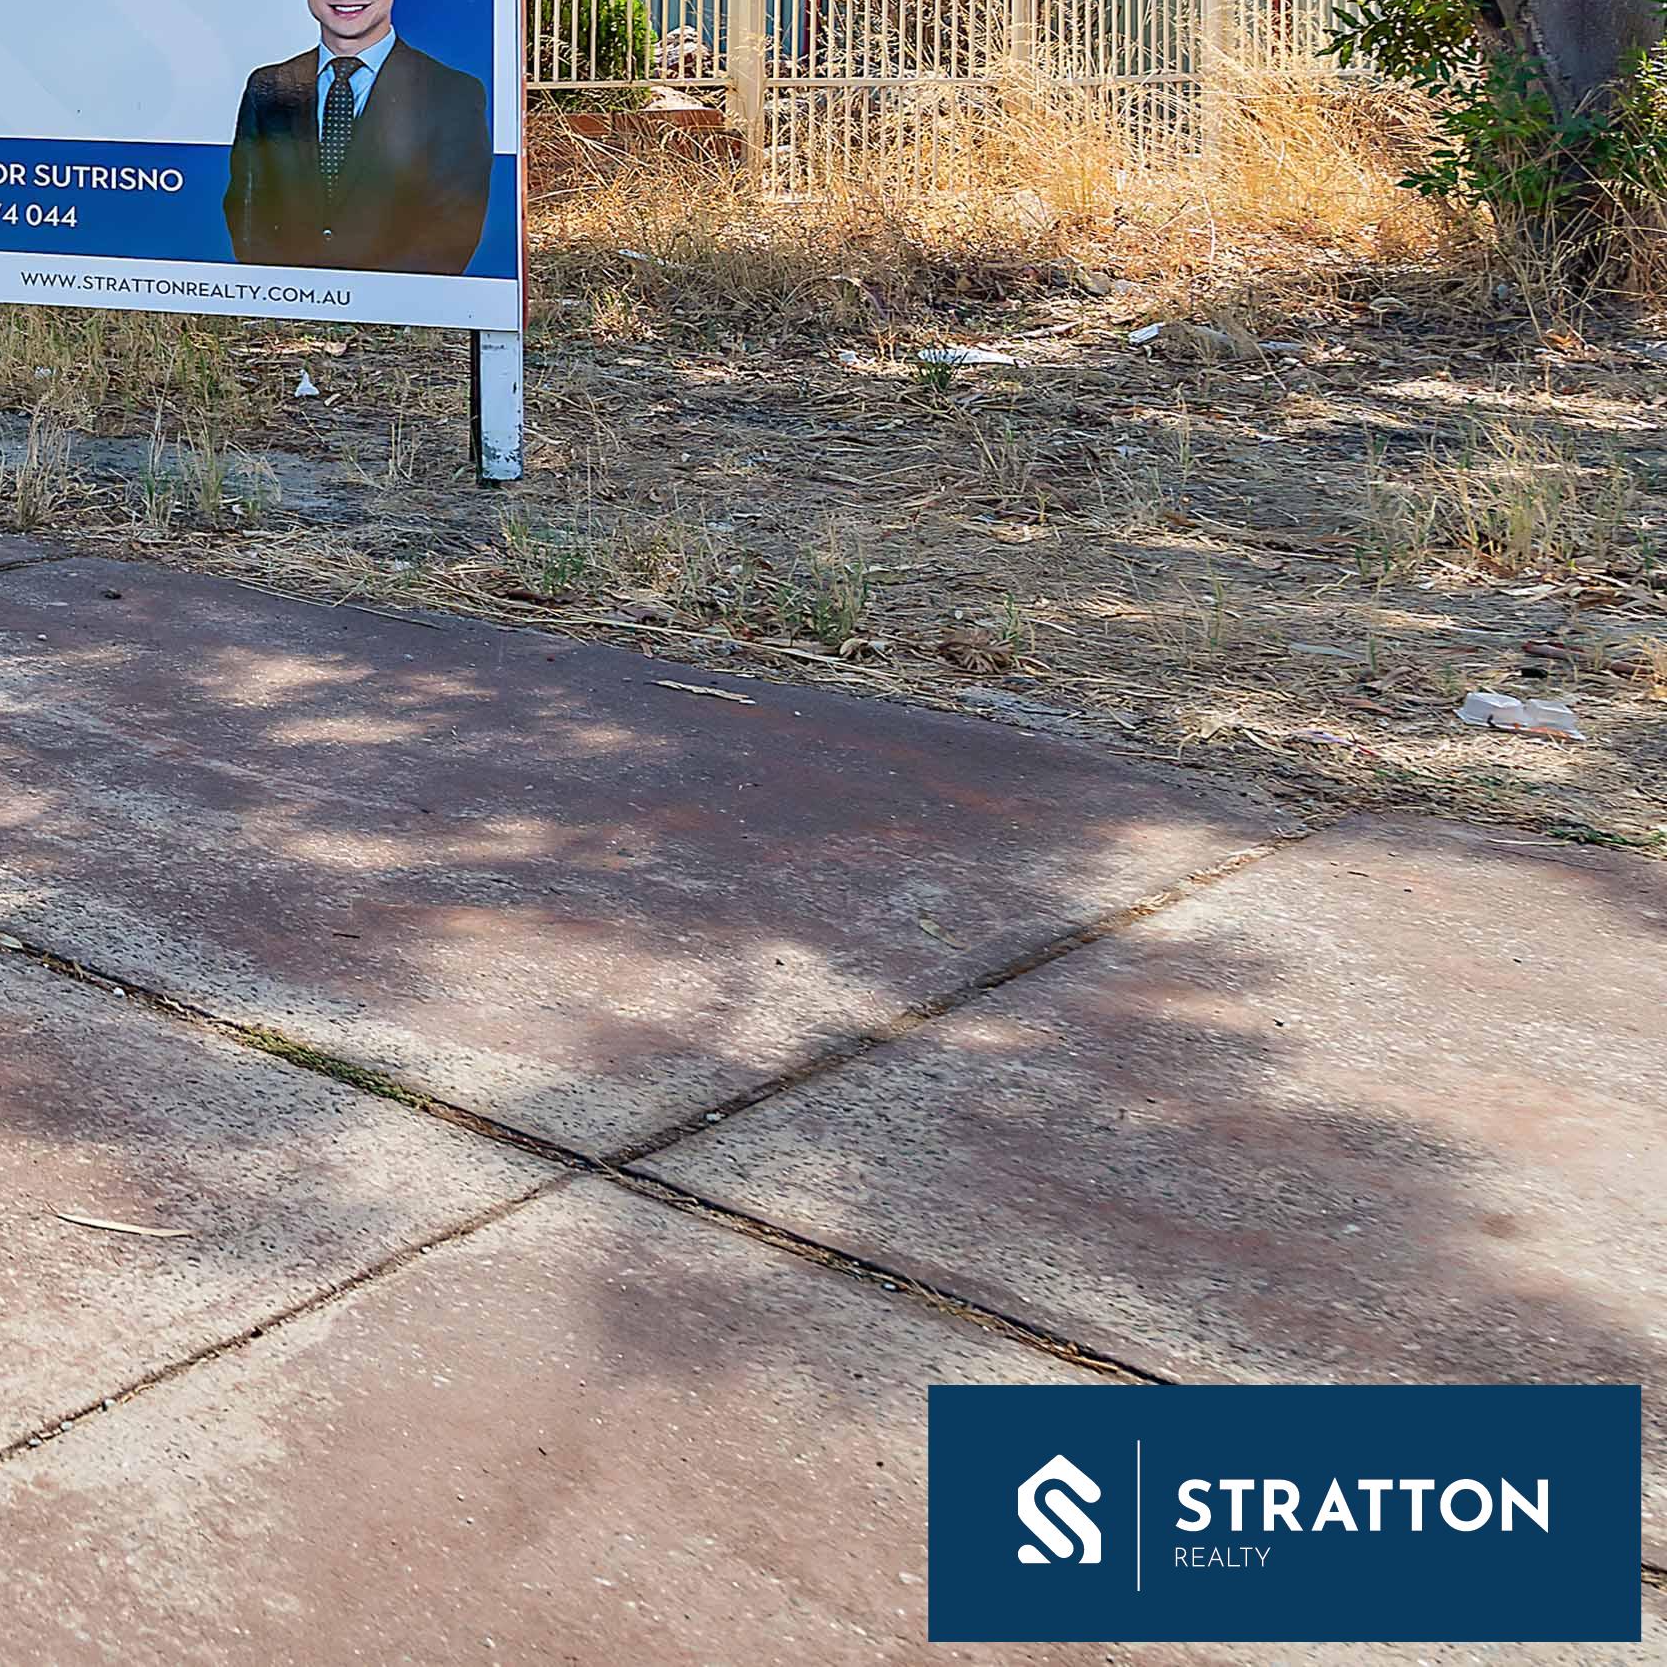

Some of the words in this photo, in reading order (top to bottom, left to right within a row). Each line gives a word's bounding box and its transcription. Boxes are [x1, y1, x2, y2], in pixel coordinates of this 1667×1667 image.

[33, 164, 184, 192] SUTRISNO
[25, 204, 78, 228] 044
[20, 271, 351, 306] WWW.STRATTONREALTY.COM.AU
